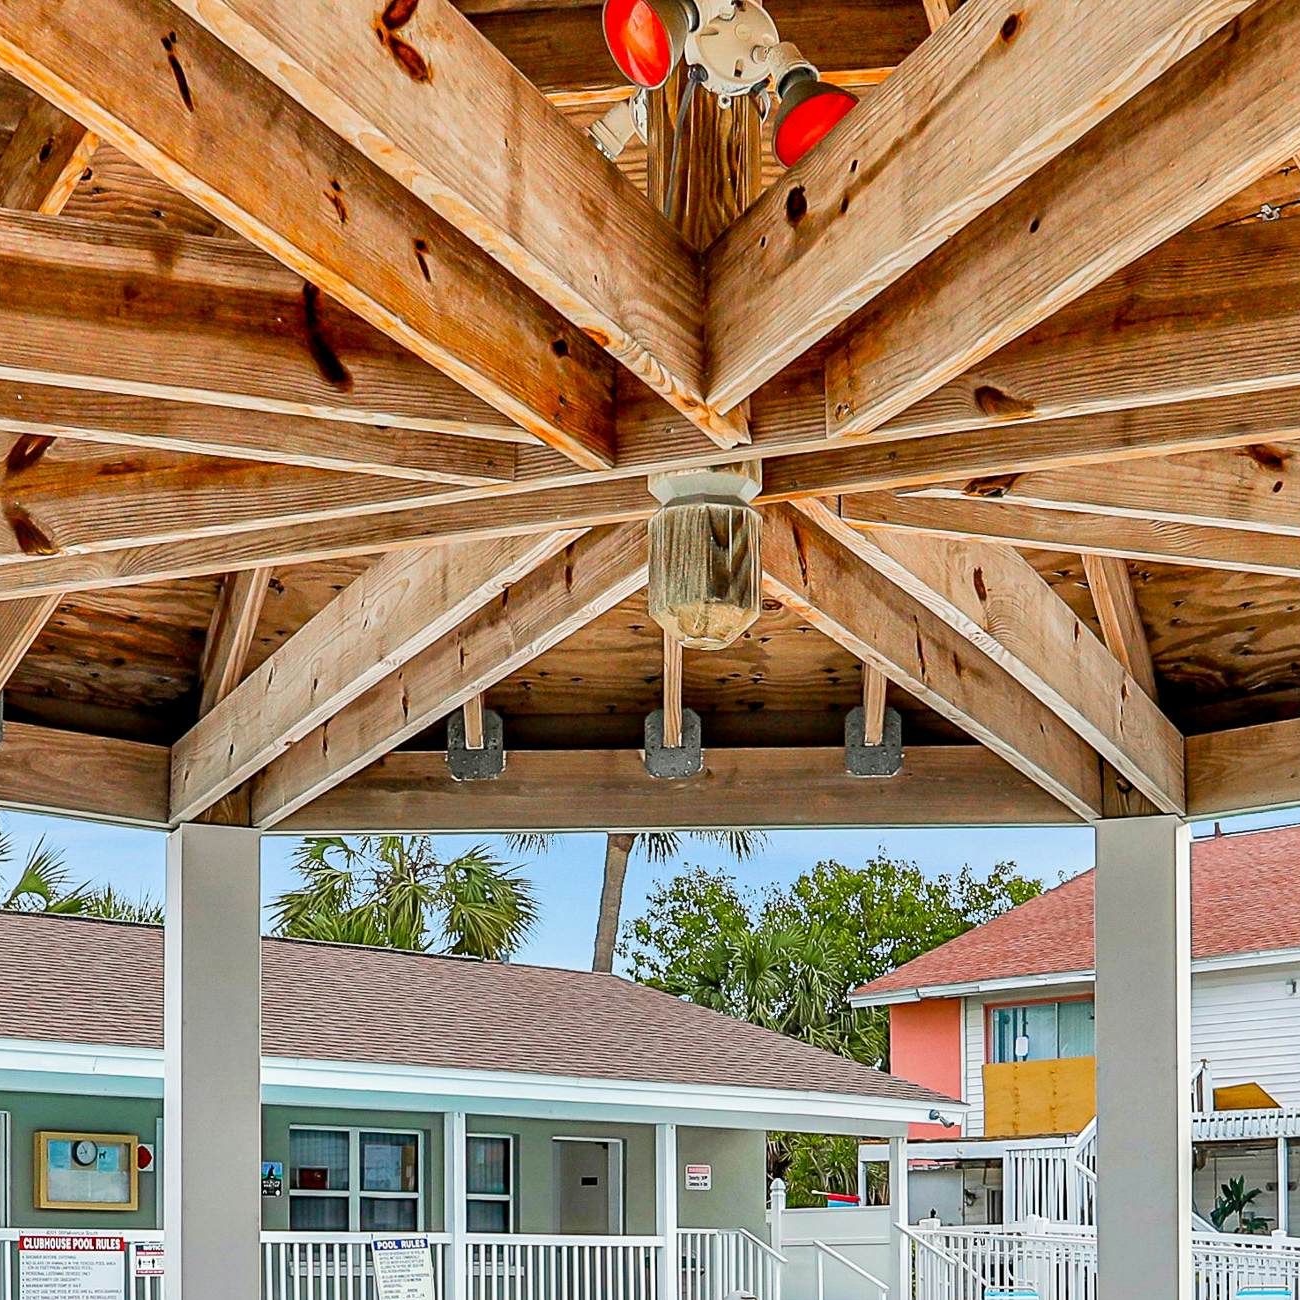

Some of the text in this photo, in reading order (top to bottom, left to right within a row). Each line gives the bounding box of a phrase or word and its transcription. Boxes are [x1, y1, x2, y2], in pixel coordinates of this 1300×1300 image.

[22, 1237, 121, 1250] CLUBHOUSE POOL RULES
[376, 1239, 426, 1250] POOL RULES
